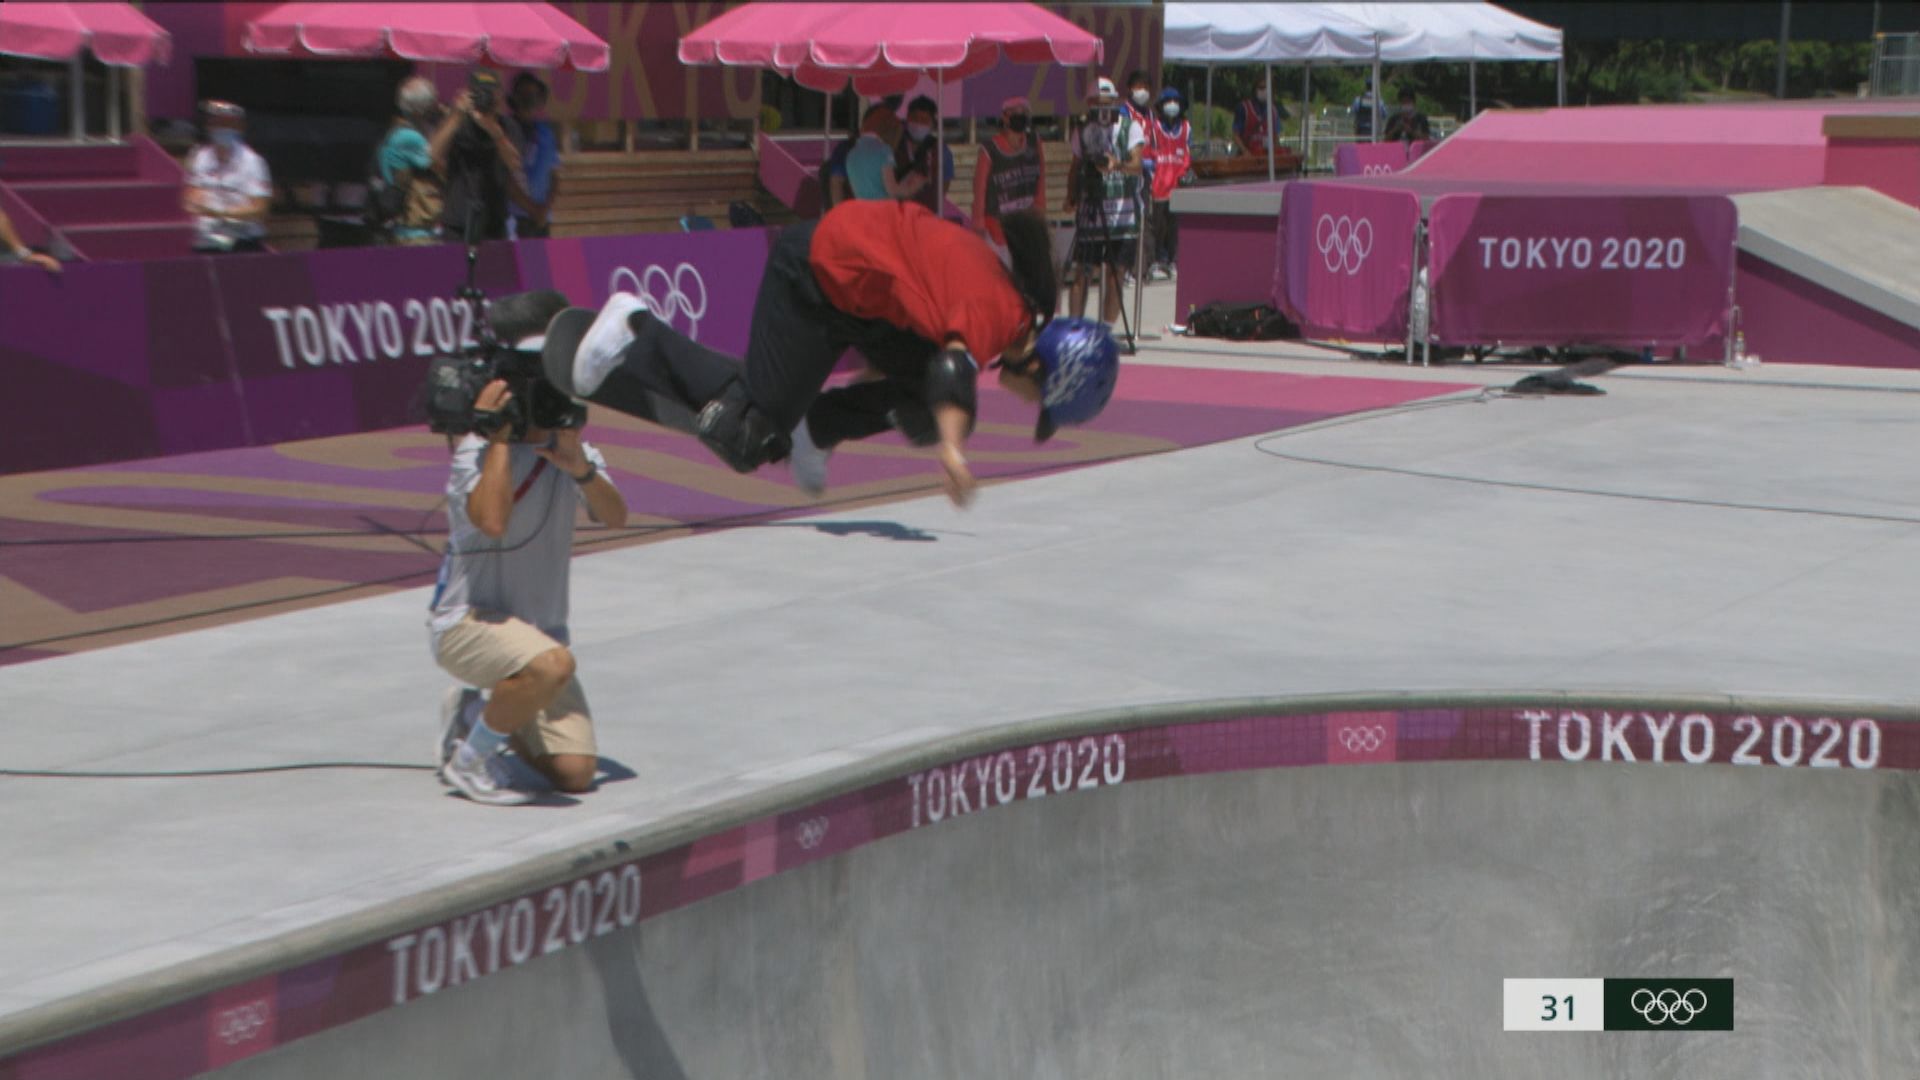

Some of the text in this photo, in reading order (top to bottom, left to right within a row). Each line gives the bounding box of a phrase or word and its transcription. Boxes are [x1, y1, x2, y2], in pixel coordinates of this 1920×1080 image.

[1478, 237, 1687, 270] TOKYO 2020
[261, 297, 492, 369] TOKYO 202
[1517, 709, 1882, 769] TOKYO 2020
[908, 733, 1126, 828] TOKYO 2020
[388, 863, 642, 1004] TOKYO 2020
